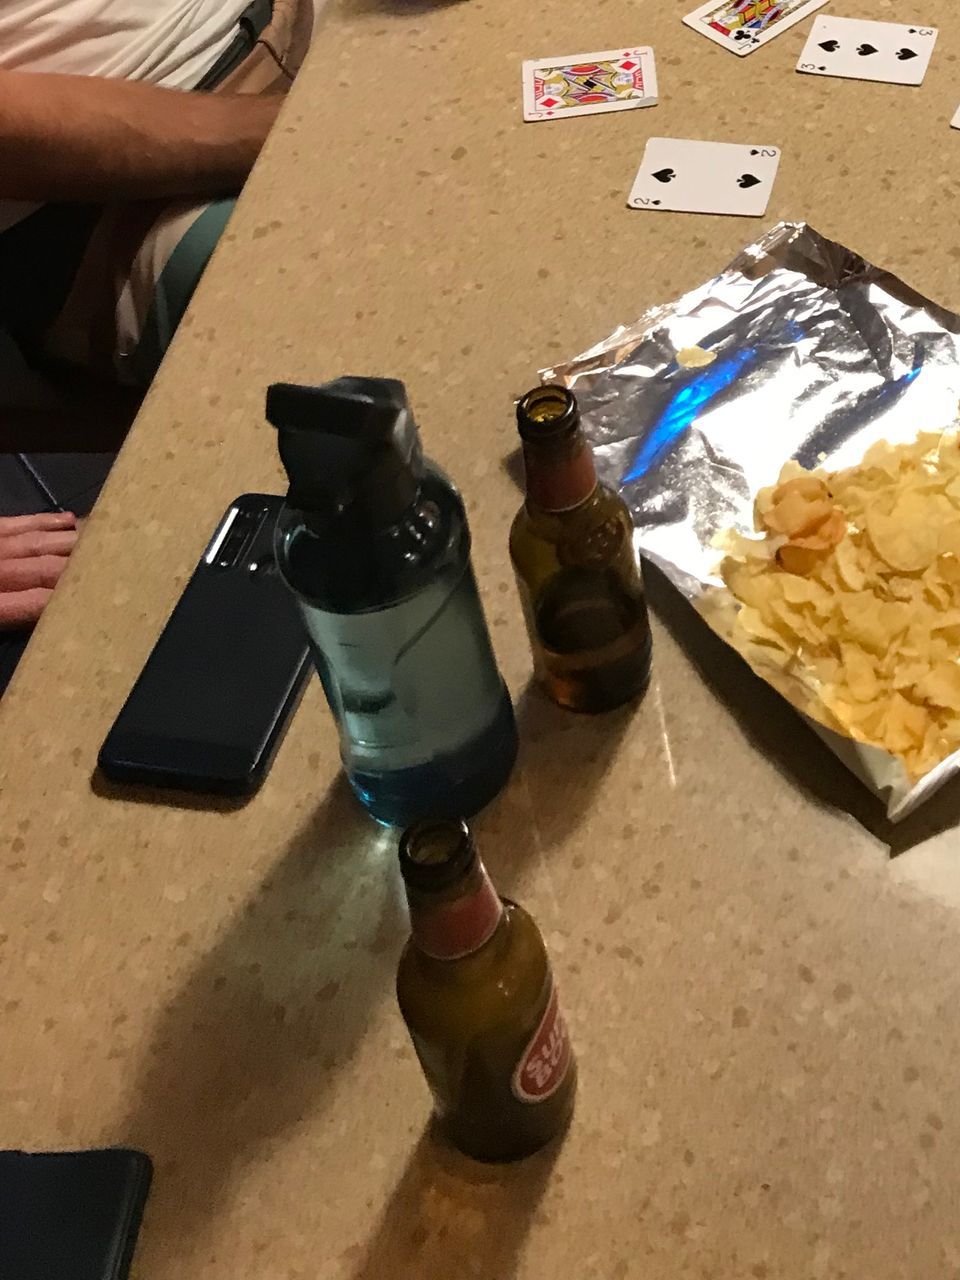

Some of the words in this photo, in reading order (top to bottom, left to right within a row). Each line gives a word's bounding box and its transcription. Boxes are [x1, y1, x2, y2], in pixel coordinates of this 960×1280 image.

[918, 28, 934, 37] 3
[800, 62, 816, 71] 3
[760, 148, 777, 158] 2
[633, 196, 650, 206] 2
